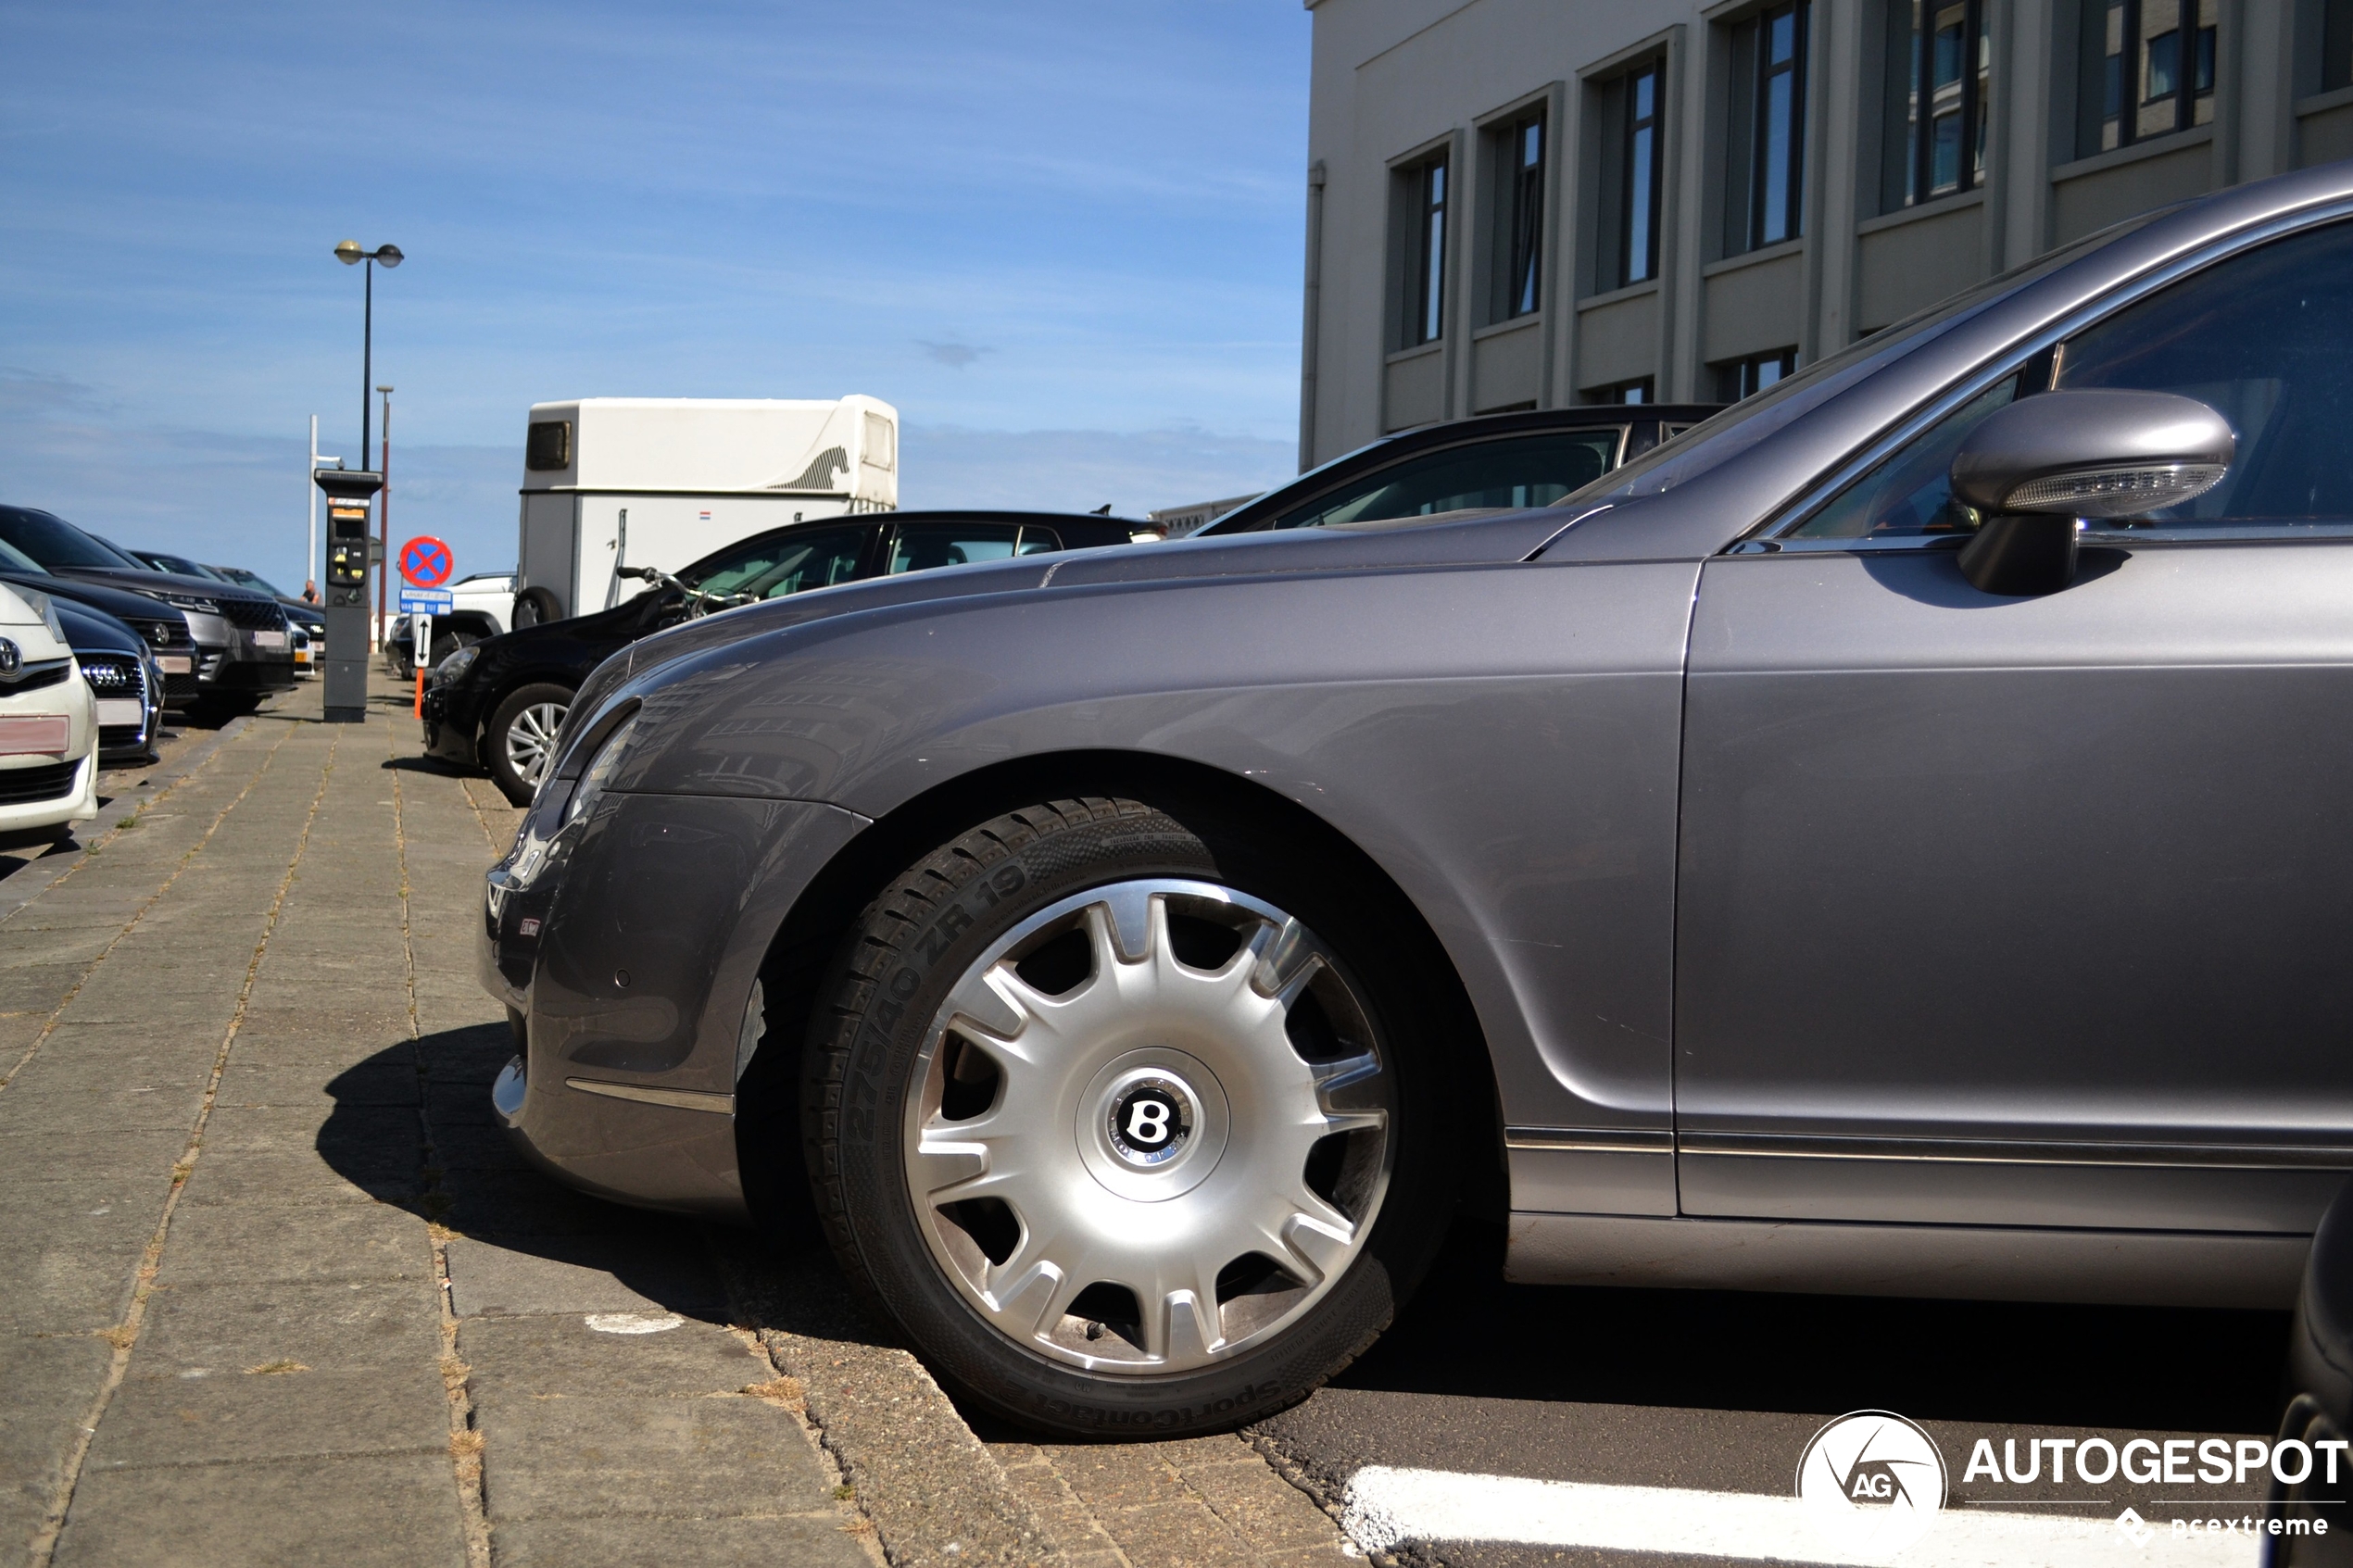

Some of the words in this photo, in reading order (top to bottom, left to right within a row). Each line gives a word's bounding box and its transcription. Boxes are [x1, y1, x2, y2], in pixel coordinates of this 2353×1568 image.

[847, 970, 920, 1141] 275/40
[914, 903, 975, 966] ZR
[975, 865, 1026, 907] 19
[1126, 1099, 1170, 1144] B
